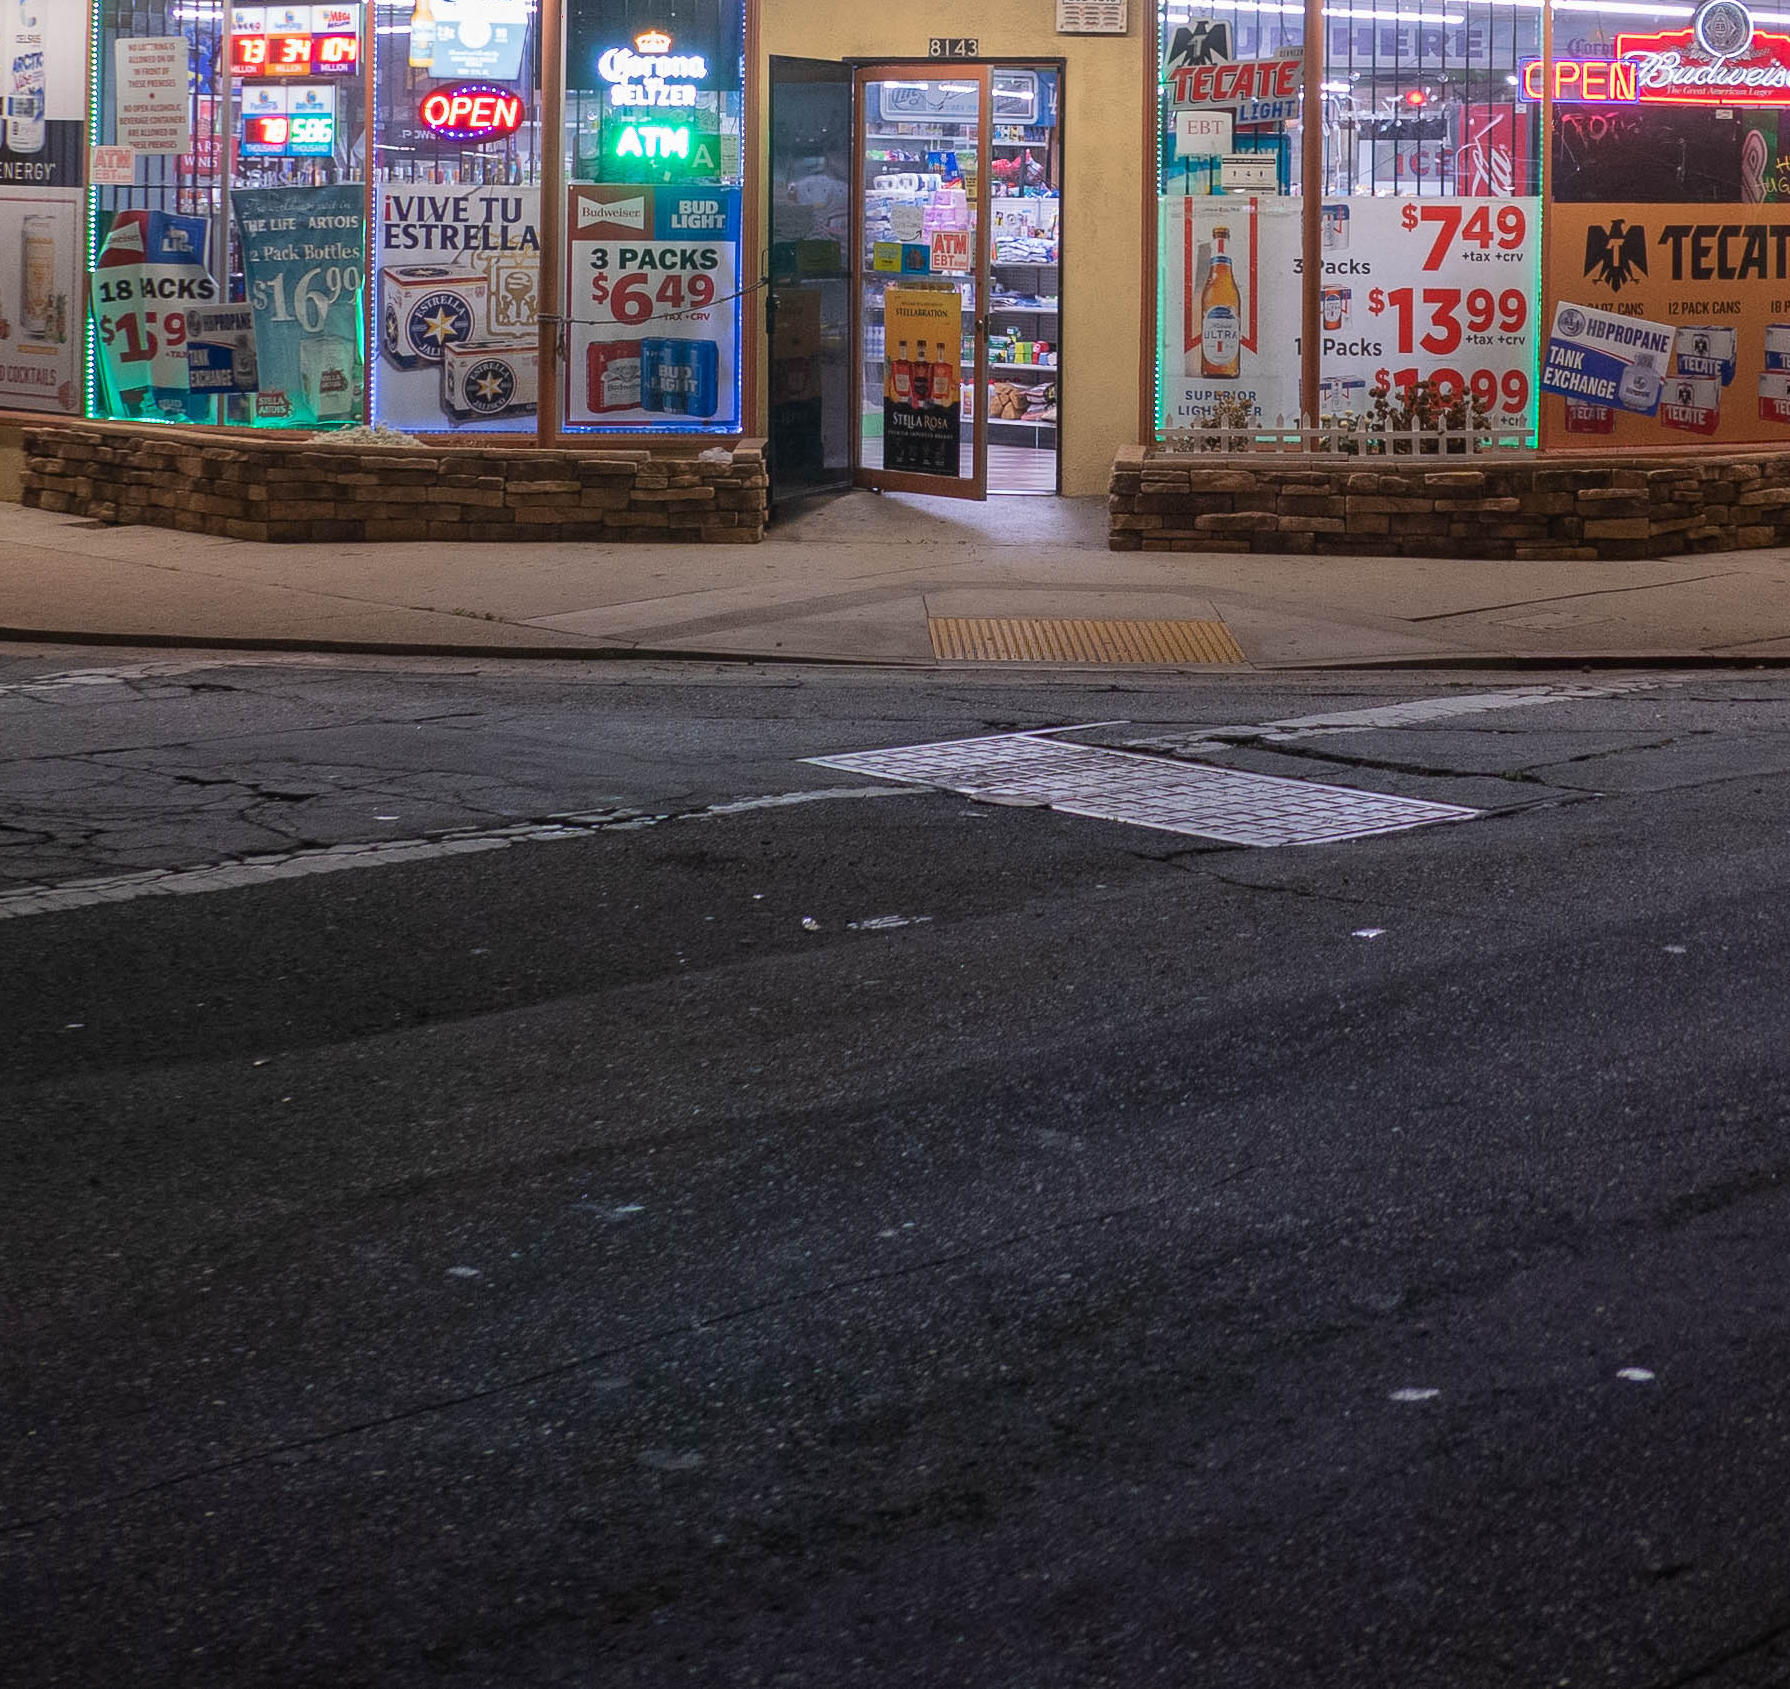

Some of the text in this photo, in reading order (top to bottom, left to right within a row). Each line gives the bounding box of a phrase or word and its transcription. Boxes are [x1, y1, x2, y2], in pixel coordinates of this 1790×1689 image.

[281, 38, 311, 62] 34
[930, 40, 978, 57] 8143
[1332, 27, 1483, 58] HERE
[1567, 38, 1614, 56] Coro
[598, 47, 708, 85] Corona
[1169, 61, 1300, 102] TECATE
[1524, 61, 1636, 101] OPEN
[1682, 86, 1706, 95] Great
[611, 84, 696, 106] SELTZER
[424, 95, 518, 127] OPEN
[1239, 100, 1295, 121] LIGHT
[1187, 121, 1224, 135] EBT
[616, 126, 690, 159] ATM
[94, 150, 131, 168] ATM
[185, 155, 218, 168] WNES
[692, 143, 714, 168] A
[1396, 149, 1455, 177] ICE
[480, 197, 523, 223] TU
[582, 207, 641, 218] Budweiser
[679, 200, 718, 214] BUD
[269, 218, 296, 230] LIFE
[308, 215, 359, 229] ARTOIS
[671, 215, 726, 229] LIGHT
[383, 224, 540, 251] ESTRELLA
[932, 234, 966, 255] ATM
[1401, 203, 1526, 271] $749
[264, 245, 299, 261] Pack
[304, 242, 360, 260] Bottles
[590, 248, 718, 270] 3 PACKS
[934, 255, 955, 266] EBT
[1462, 252, 1524, 262] +tax +crv
[100, 280, 133, 303] 18
[592, 271, 715, 326] $649
[416, 296, 466, 319] ESTRELLA
[1616, 302, 1644, 315] CANS
[1668, 301, 1741, 315] 12 PACK CANS
[1368, 287, 1527, 355] $1399
[1204, 330, 1237, 340] ULTRA
[1465, 335, 1526, 345] +tax +crv
[1587, 318, 1670, 354] HBPROPANE
[1323, 339, 1382, 356] Packs
[1549, 345, 1585, 371] TANK
[8, 365, 56, 386] COCKTAILS
[1543, 367, 1617, 400] EXCHANGE
[893, 412, 948, 431] STELLA ROSA
[1179, 406, 1214, 416] LIGH
